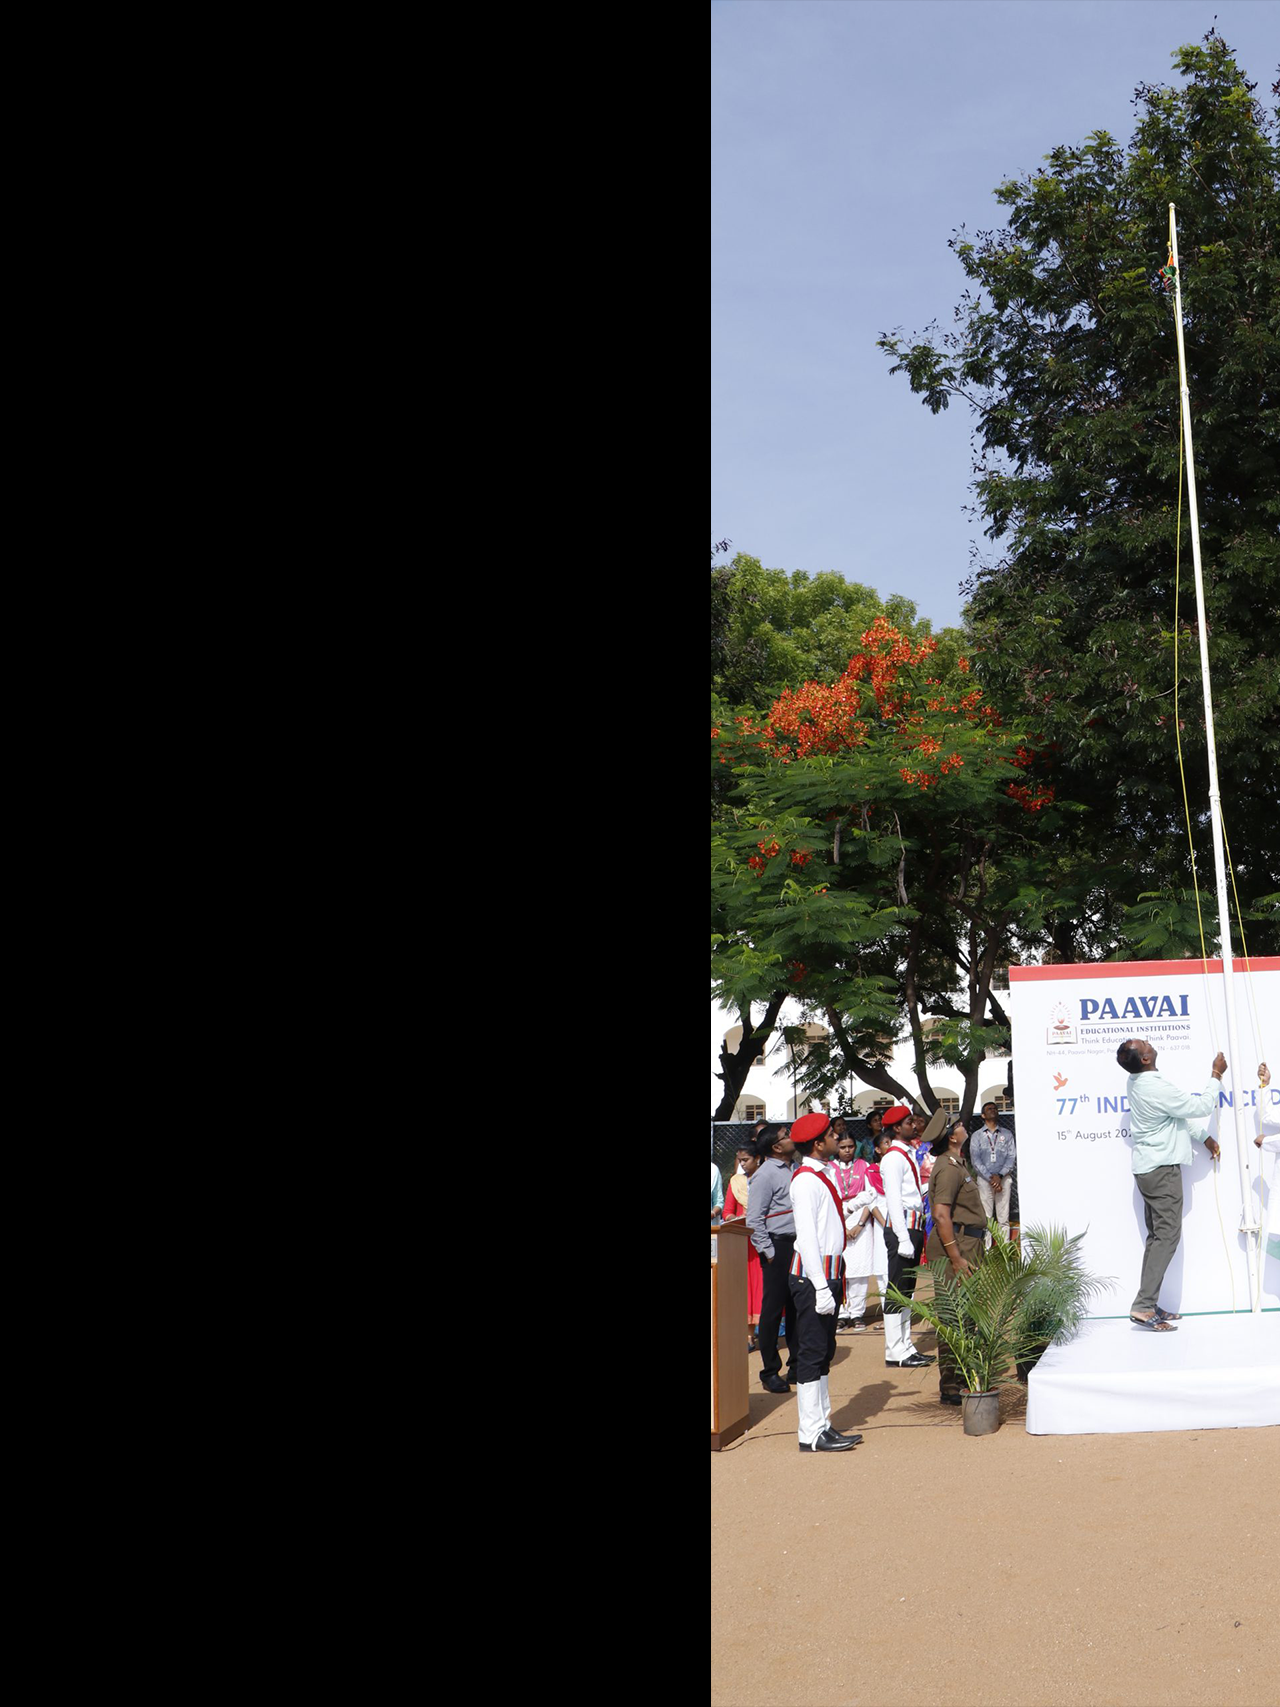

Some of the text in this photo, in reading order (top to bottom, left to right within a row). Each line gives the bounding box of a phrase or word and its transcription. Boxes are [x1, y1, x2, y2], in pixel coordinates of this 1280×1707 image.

[1079, 994, 1190, 1020] PAAVAI
[1080, 1024, 1191, 1035] EDUCATIONAL INSTITUTIONS
[1075, 1131, 1112, 1142] August
[1115, 1129, 1132, 1138] 20
